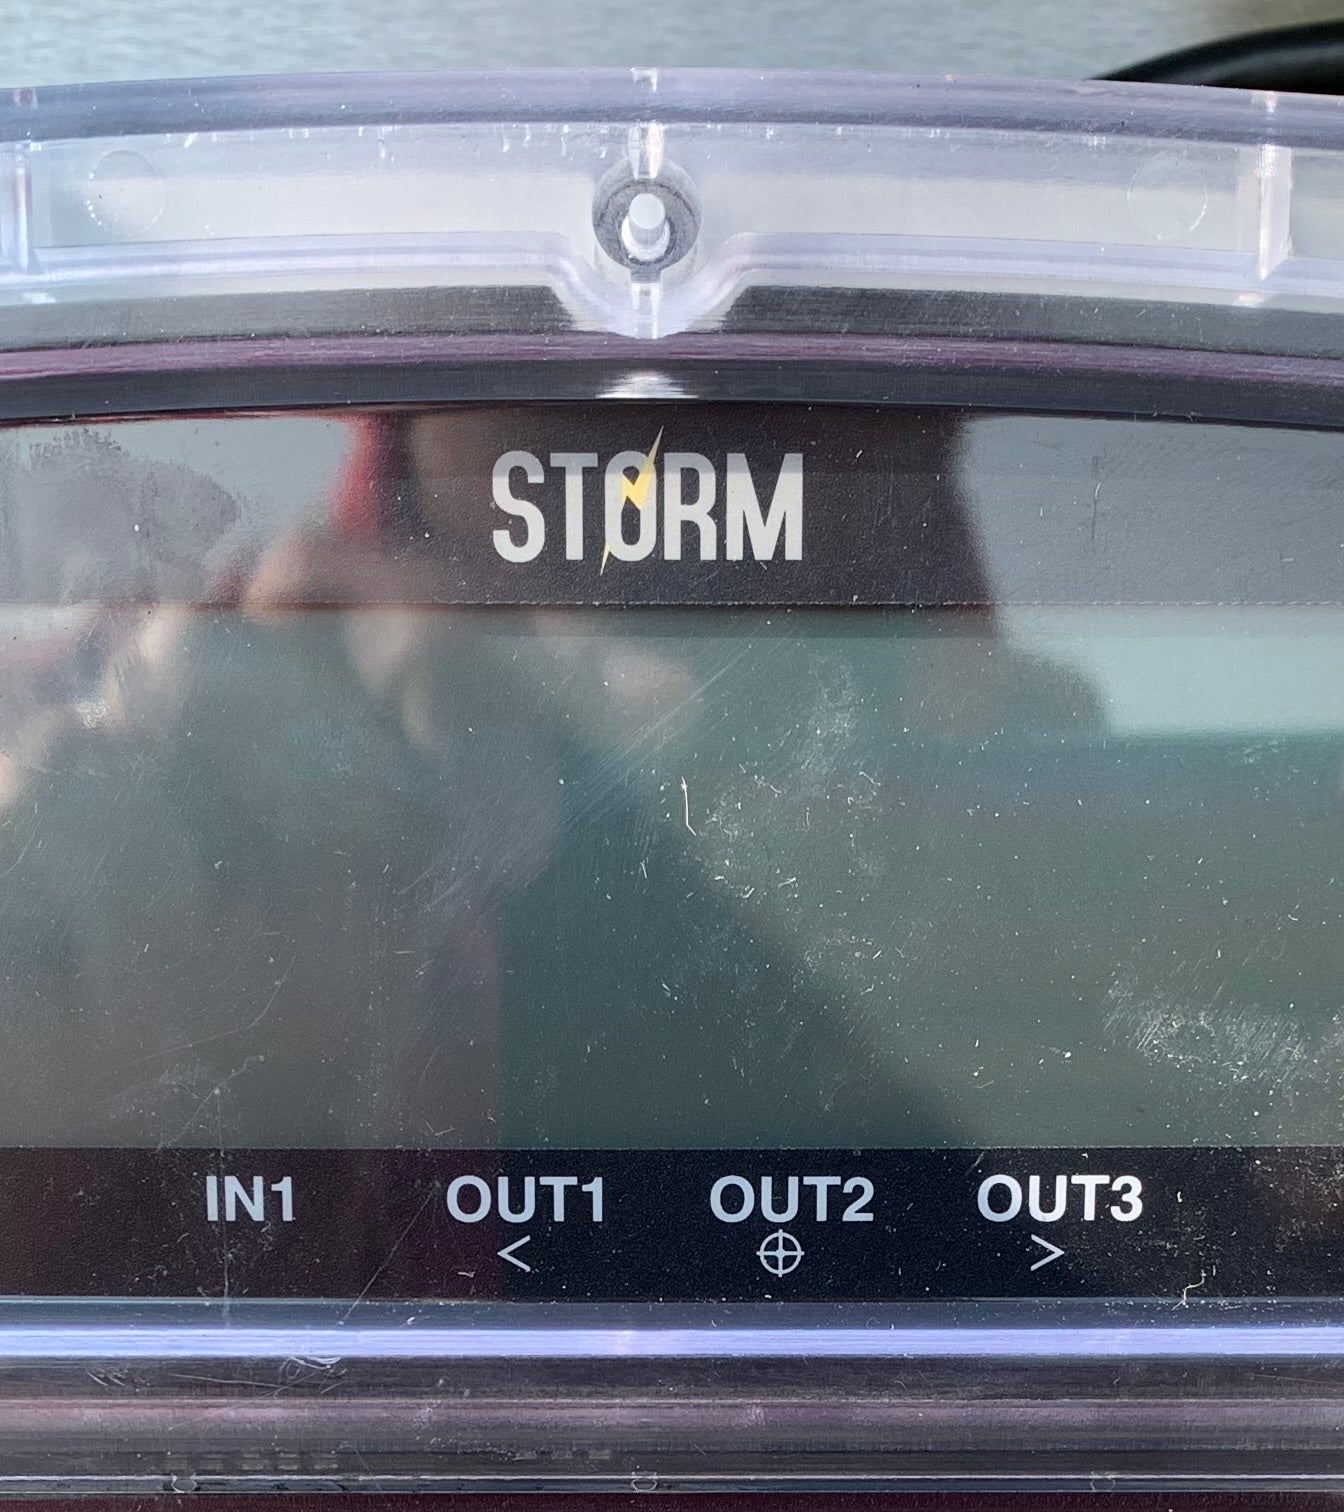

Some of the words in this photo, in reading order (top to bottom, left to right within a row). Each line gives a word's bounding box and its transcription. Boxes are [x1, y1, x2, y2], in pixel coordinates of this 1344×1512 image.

[492, 450, 803, 563] STORM
[206, 1175, 295, 1222] IN1
[445, 1174, 606, 1223] OUT1
[710, 1174, 875, 1223] OUT2
[977, 1173, 1143, 1223] OUT3
